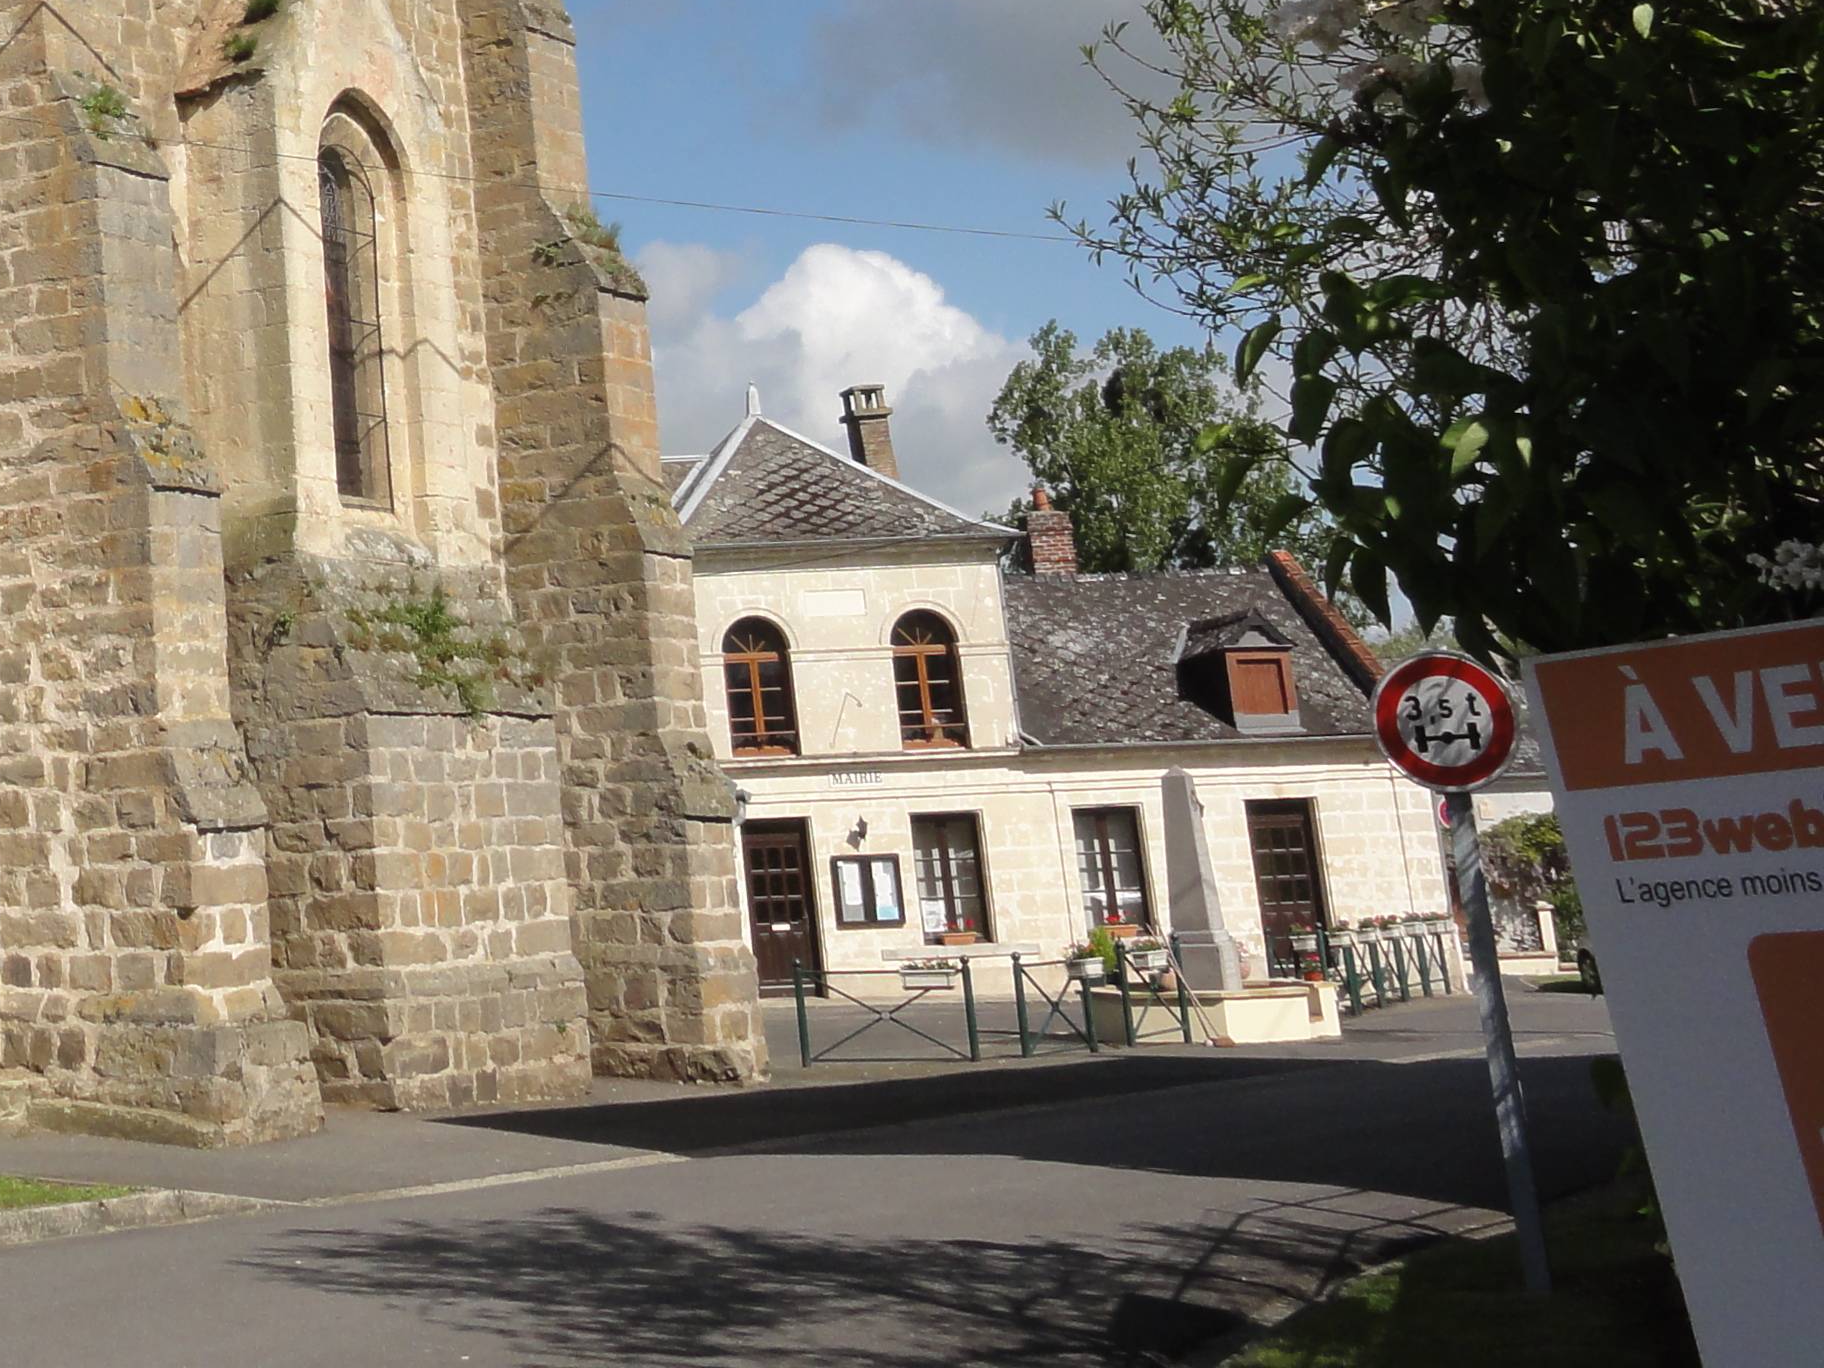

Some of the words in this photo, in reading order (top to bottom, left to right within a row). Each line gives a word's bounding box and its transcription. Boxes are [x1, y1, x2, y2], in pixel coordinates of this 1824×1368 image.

[1404, 695, 1453, 725] 3,5
[1465, 692, 1481, 717] t
[1617, 664, 1685, 765] À
[1691, 658, 1824, 754] VE
[831, 772, 882, 785] MAIRIE
[1616, 878, 1733, 908] L'agence
[1742, 867, 1823, 897] moins
